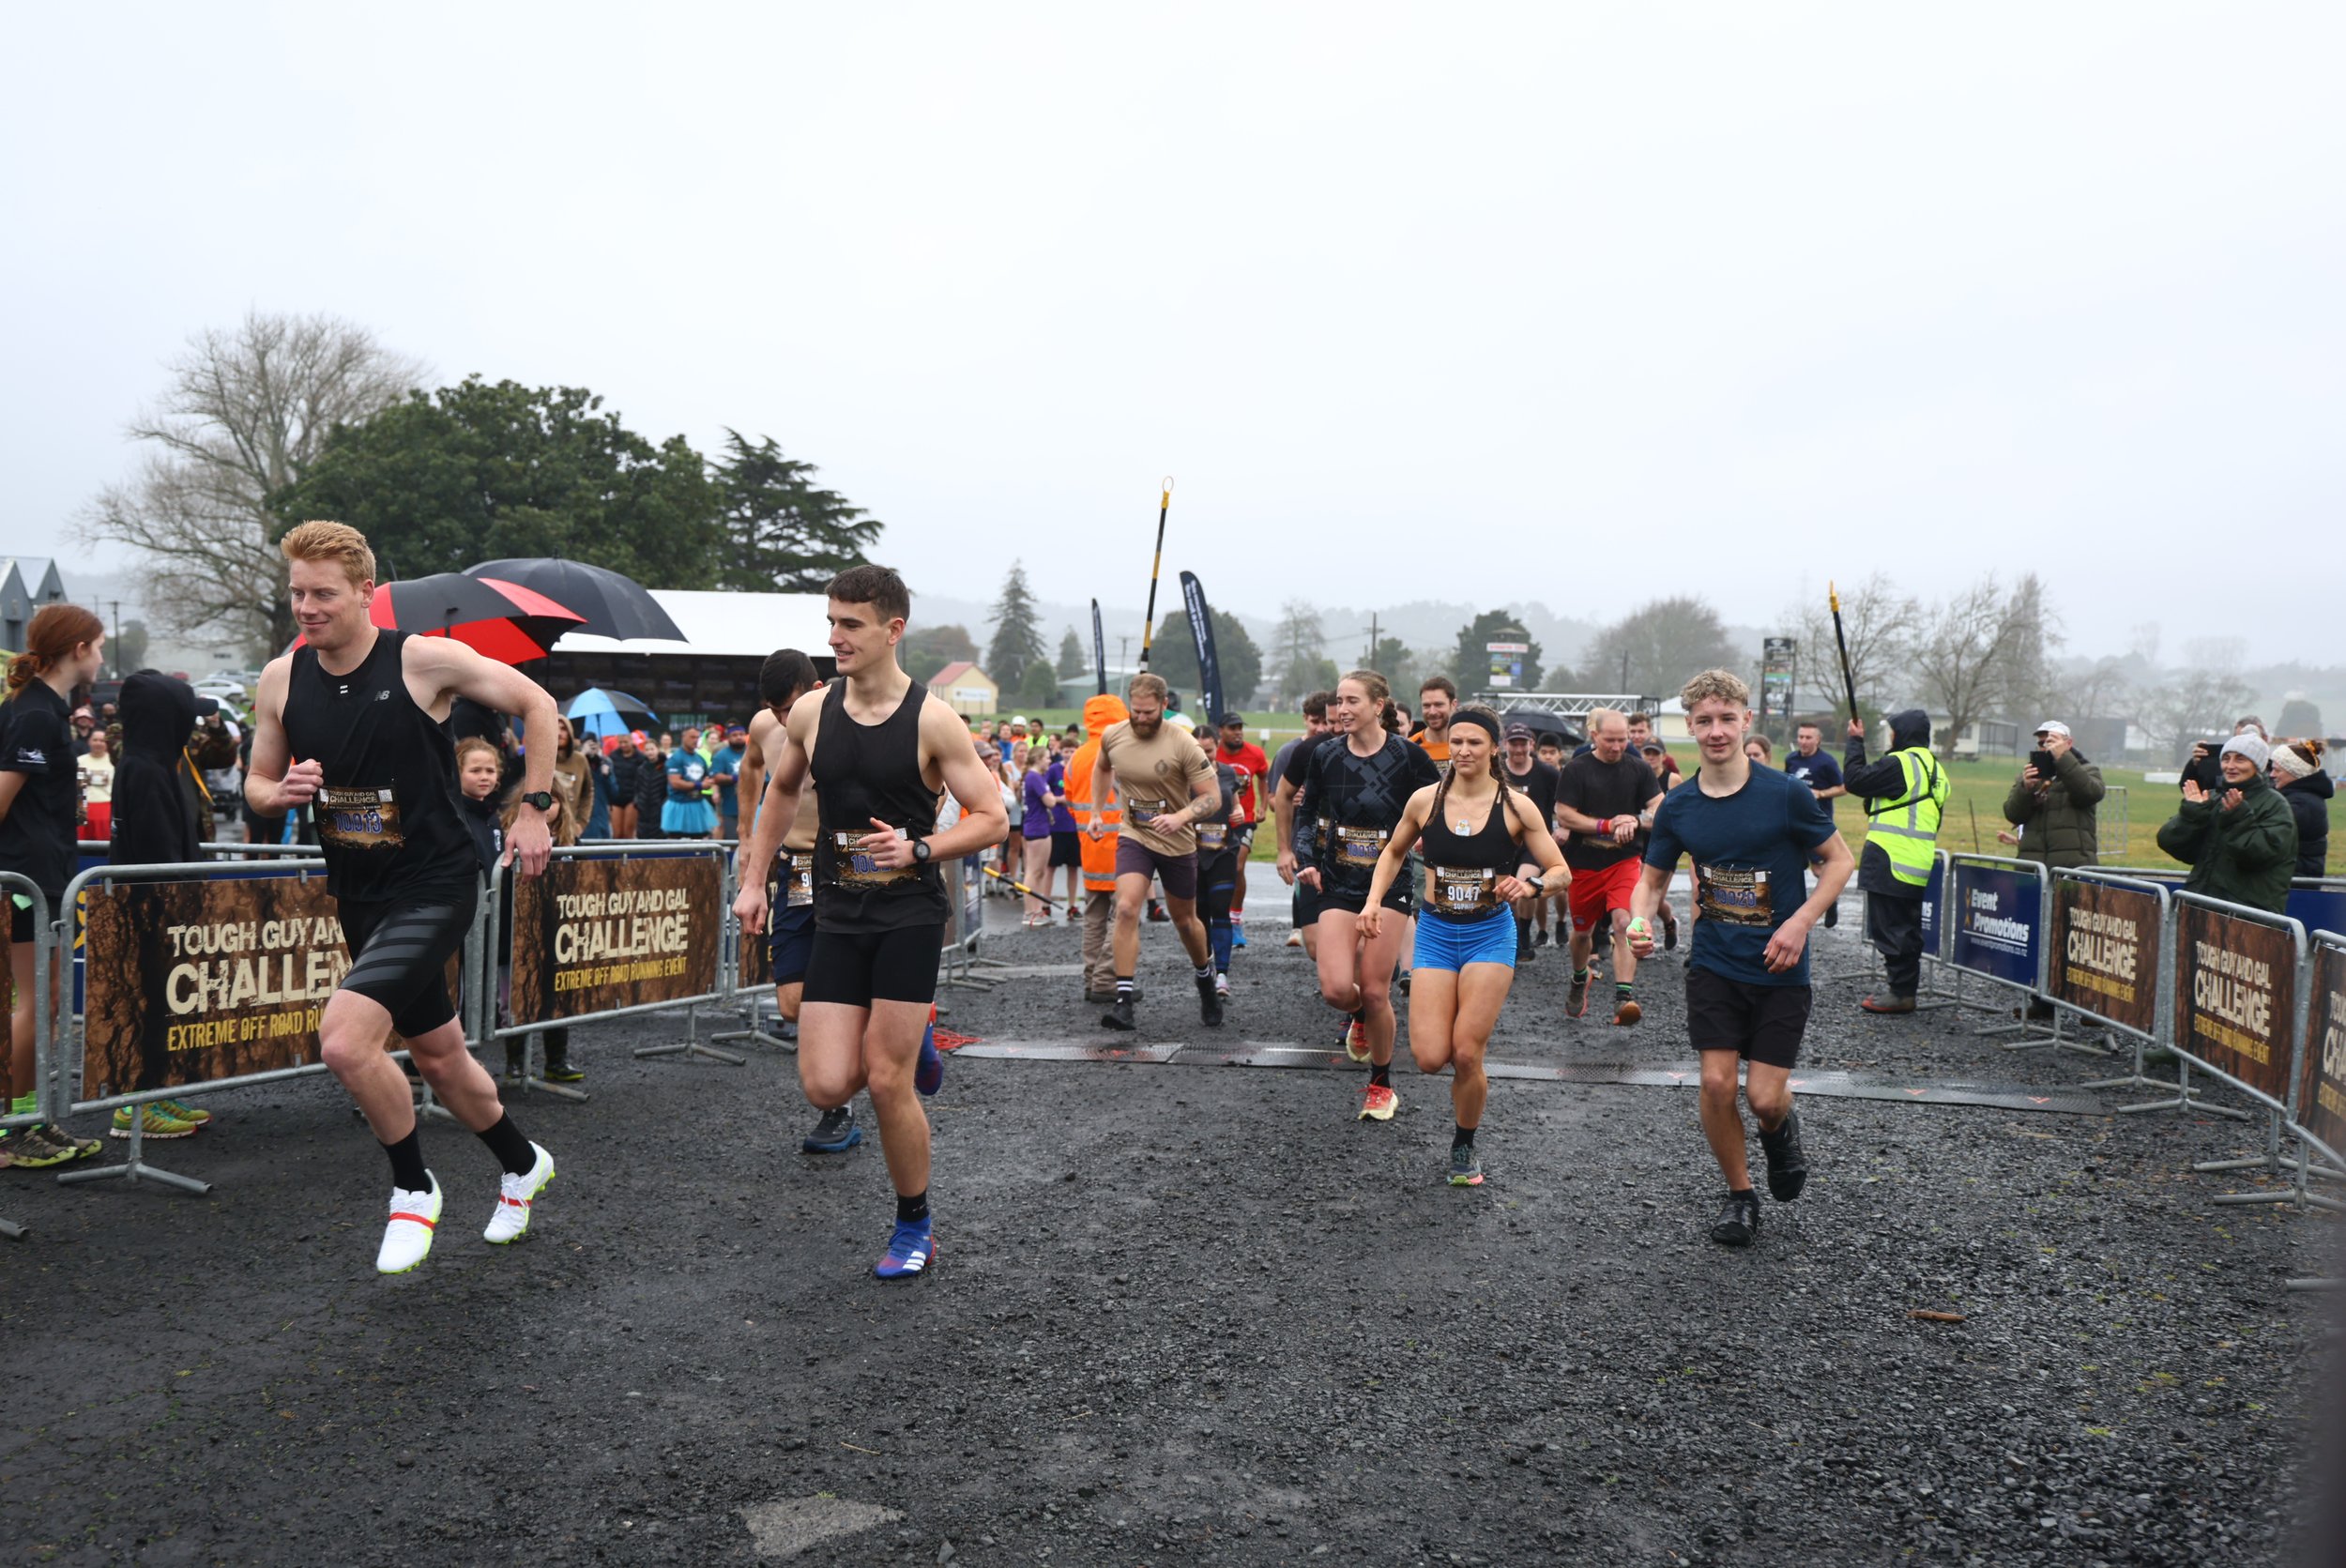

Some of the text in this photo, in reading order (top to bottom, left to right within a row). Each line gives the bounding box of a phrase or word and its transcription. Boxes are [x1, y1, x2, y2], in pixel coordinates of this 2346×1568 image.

[329, 796, 378, 804] CHALLENGE
[334, 812, 383, 833] 10013
[1447, 886, 1480, 901] 9047
[1713, 874, 1754, 883] CHALLENGE
[556, 888, 690, 919] TOUGH GUY AND GAL
[1713, 888, 1757, 908] 10020
[1972, 889, 1998, 911] Event
[167, 916, 346, 957] TOUGH GUY AN
[555, 914, 689, 964] CHALLENGE
[1973, 912, 2030, 942] Promotions
[2069, 906, 2138, 942] TOUGH GUY AND GAL
[555, 967, 592, 992] EXTREME
[594, 965, 609, 986] OFF
[630, 959, 663, 981] RUNNING
[664, 956, 688, 976] EVENT
[2067, 930, 2138, 982] CHALLENGE
[2196, 940, 2271, 990] TOUGH GUY AND GAL
[166, 951, 354, 1015] CHALLEN
[2194, 969, 2271, 1038] CHALLENGE
[167, 1019, 236, 1051] EXTREME
[241, 1015, 267, 1042] OFF
[269, 1011, 303, 1038] ROAD
